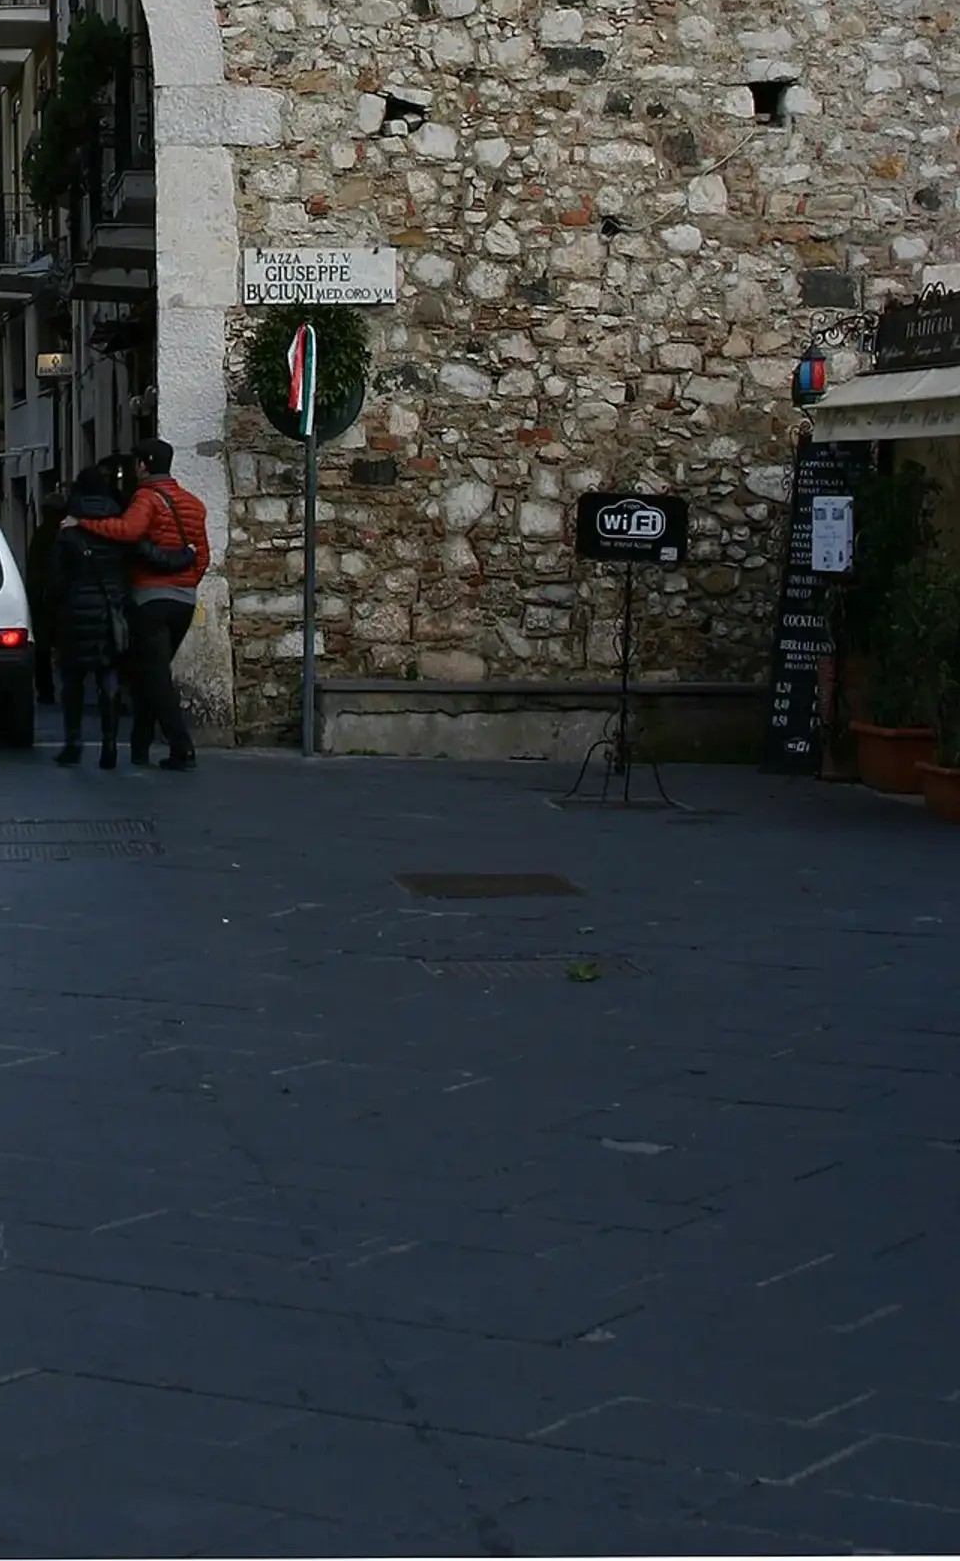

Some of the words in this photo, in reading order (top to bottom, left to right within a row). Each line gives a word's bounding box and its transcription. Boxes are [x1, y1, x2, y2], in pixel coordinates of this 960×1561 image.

[256, 253, 301, 265] PIAZZA
[265, 266, 351, 282] GIUSEPPE
[247, 284, 314, 300] BUCIUNI
[345, 288, 371, 300] ORO
[603, 513, 657, 531] WiFi
